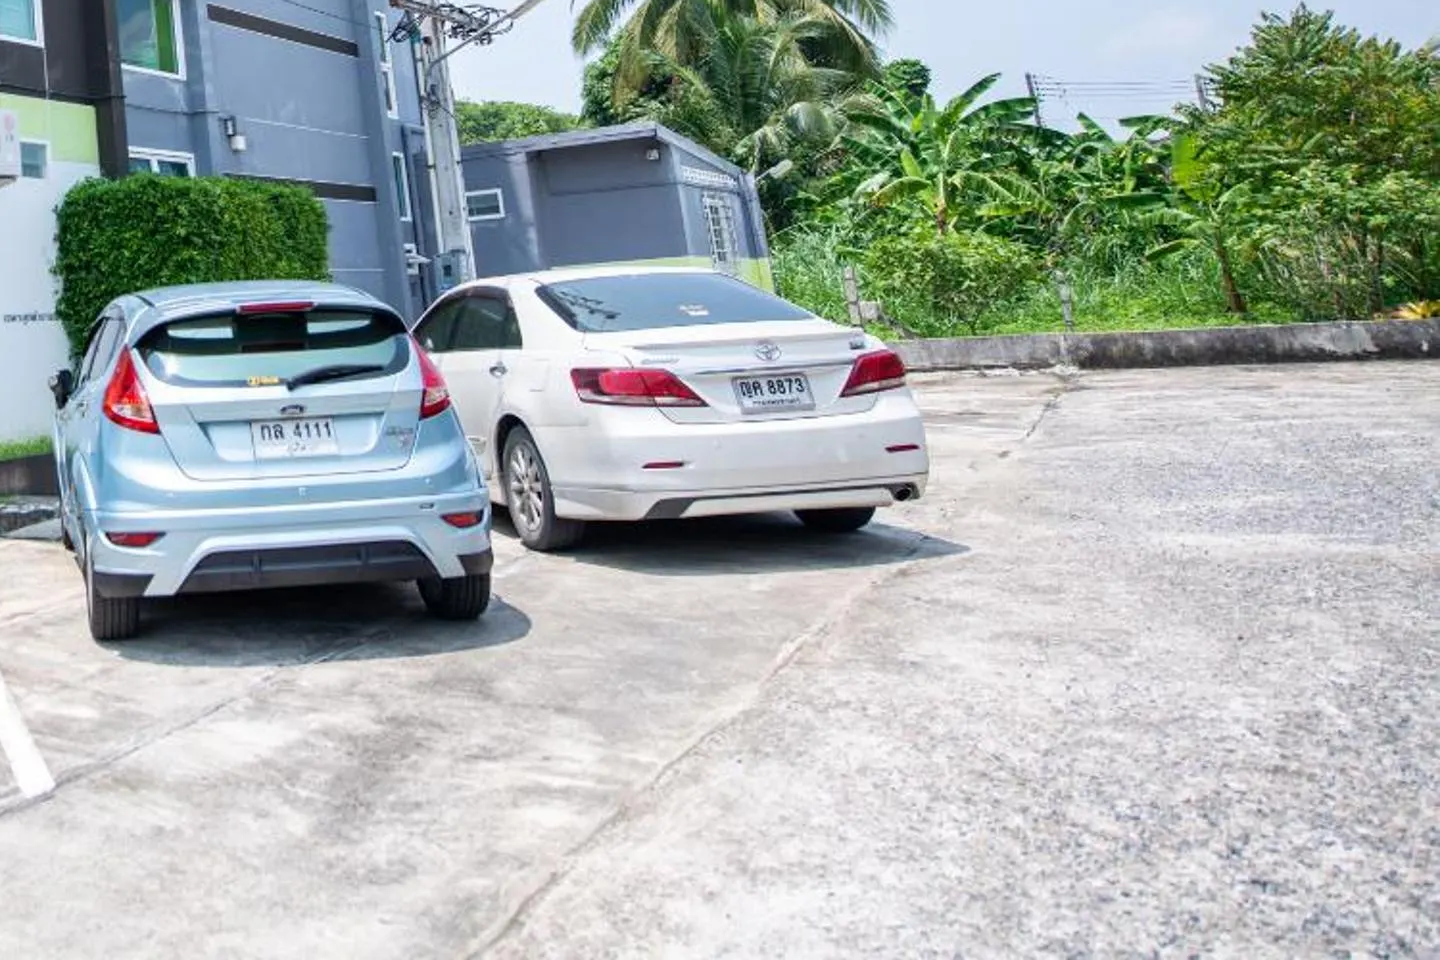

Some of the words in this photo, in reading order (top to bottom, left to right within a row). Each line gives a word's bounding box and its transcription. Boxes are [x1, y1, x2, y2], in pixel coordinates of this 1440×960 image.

[766, 377, 805, 395] 8873
[260, 423, 285, 441] กล
[292, 421, 332, 439] 4111
